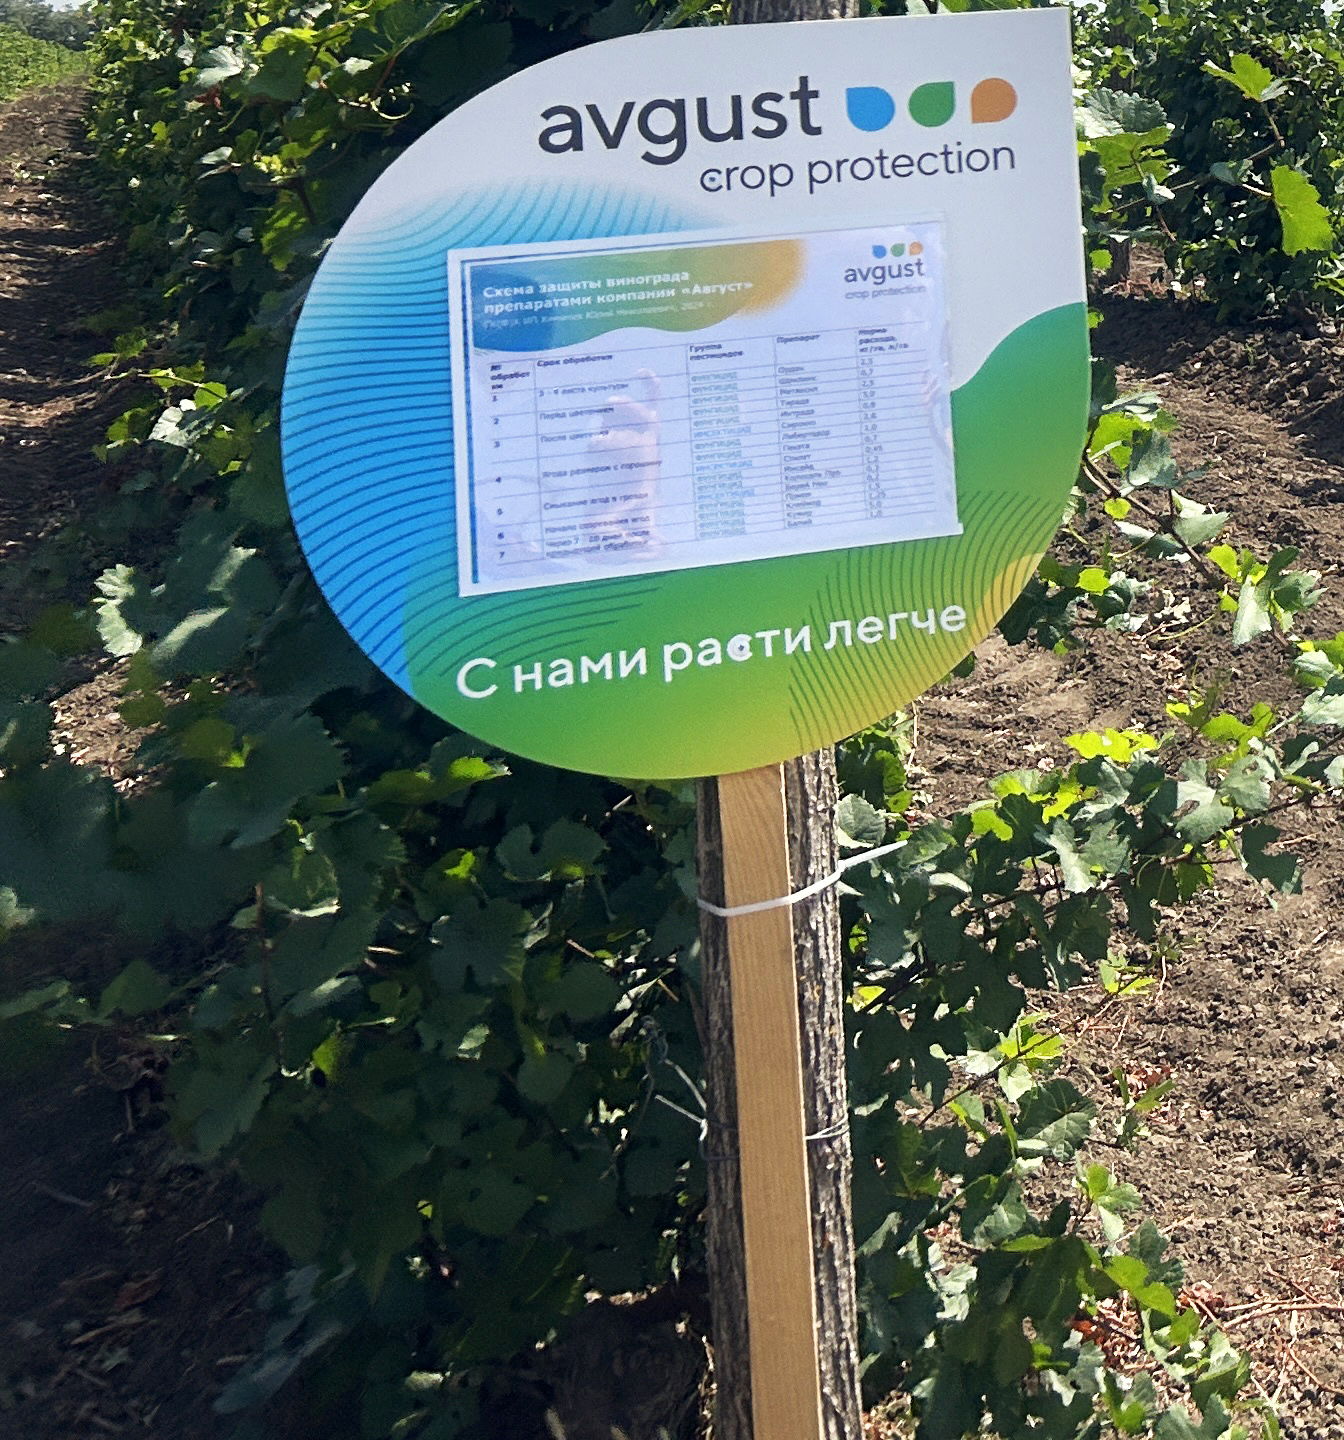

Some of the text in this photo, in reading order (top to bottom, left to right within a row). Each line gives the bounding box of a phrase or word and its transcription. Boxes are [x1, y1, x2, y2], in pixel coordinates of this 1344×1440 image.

[539, 75, 823, 165] avgust
[699, 141, 1017, 197] crop protection
[482, 271, 690, 299] Схема защиты винограда
[844, 258, 925, 285] avgust
[483, 296, 593, 316] препаратами
[596, 287, 676, 304] компании
[456, 601, 967, 700] С нами расти легче
